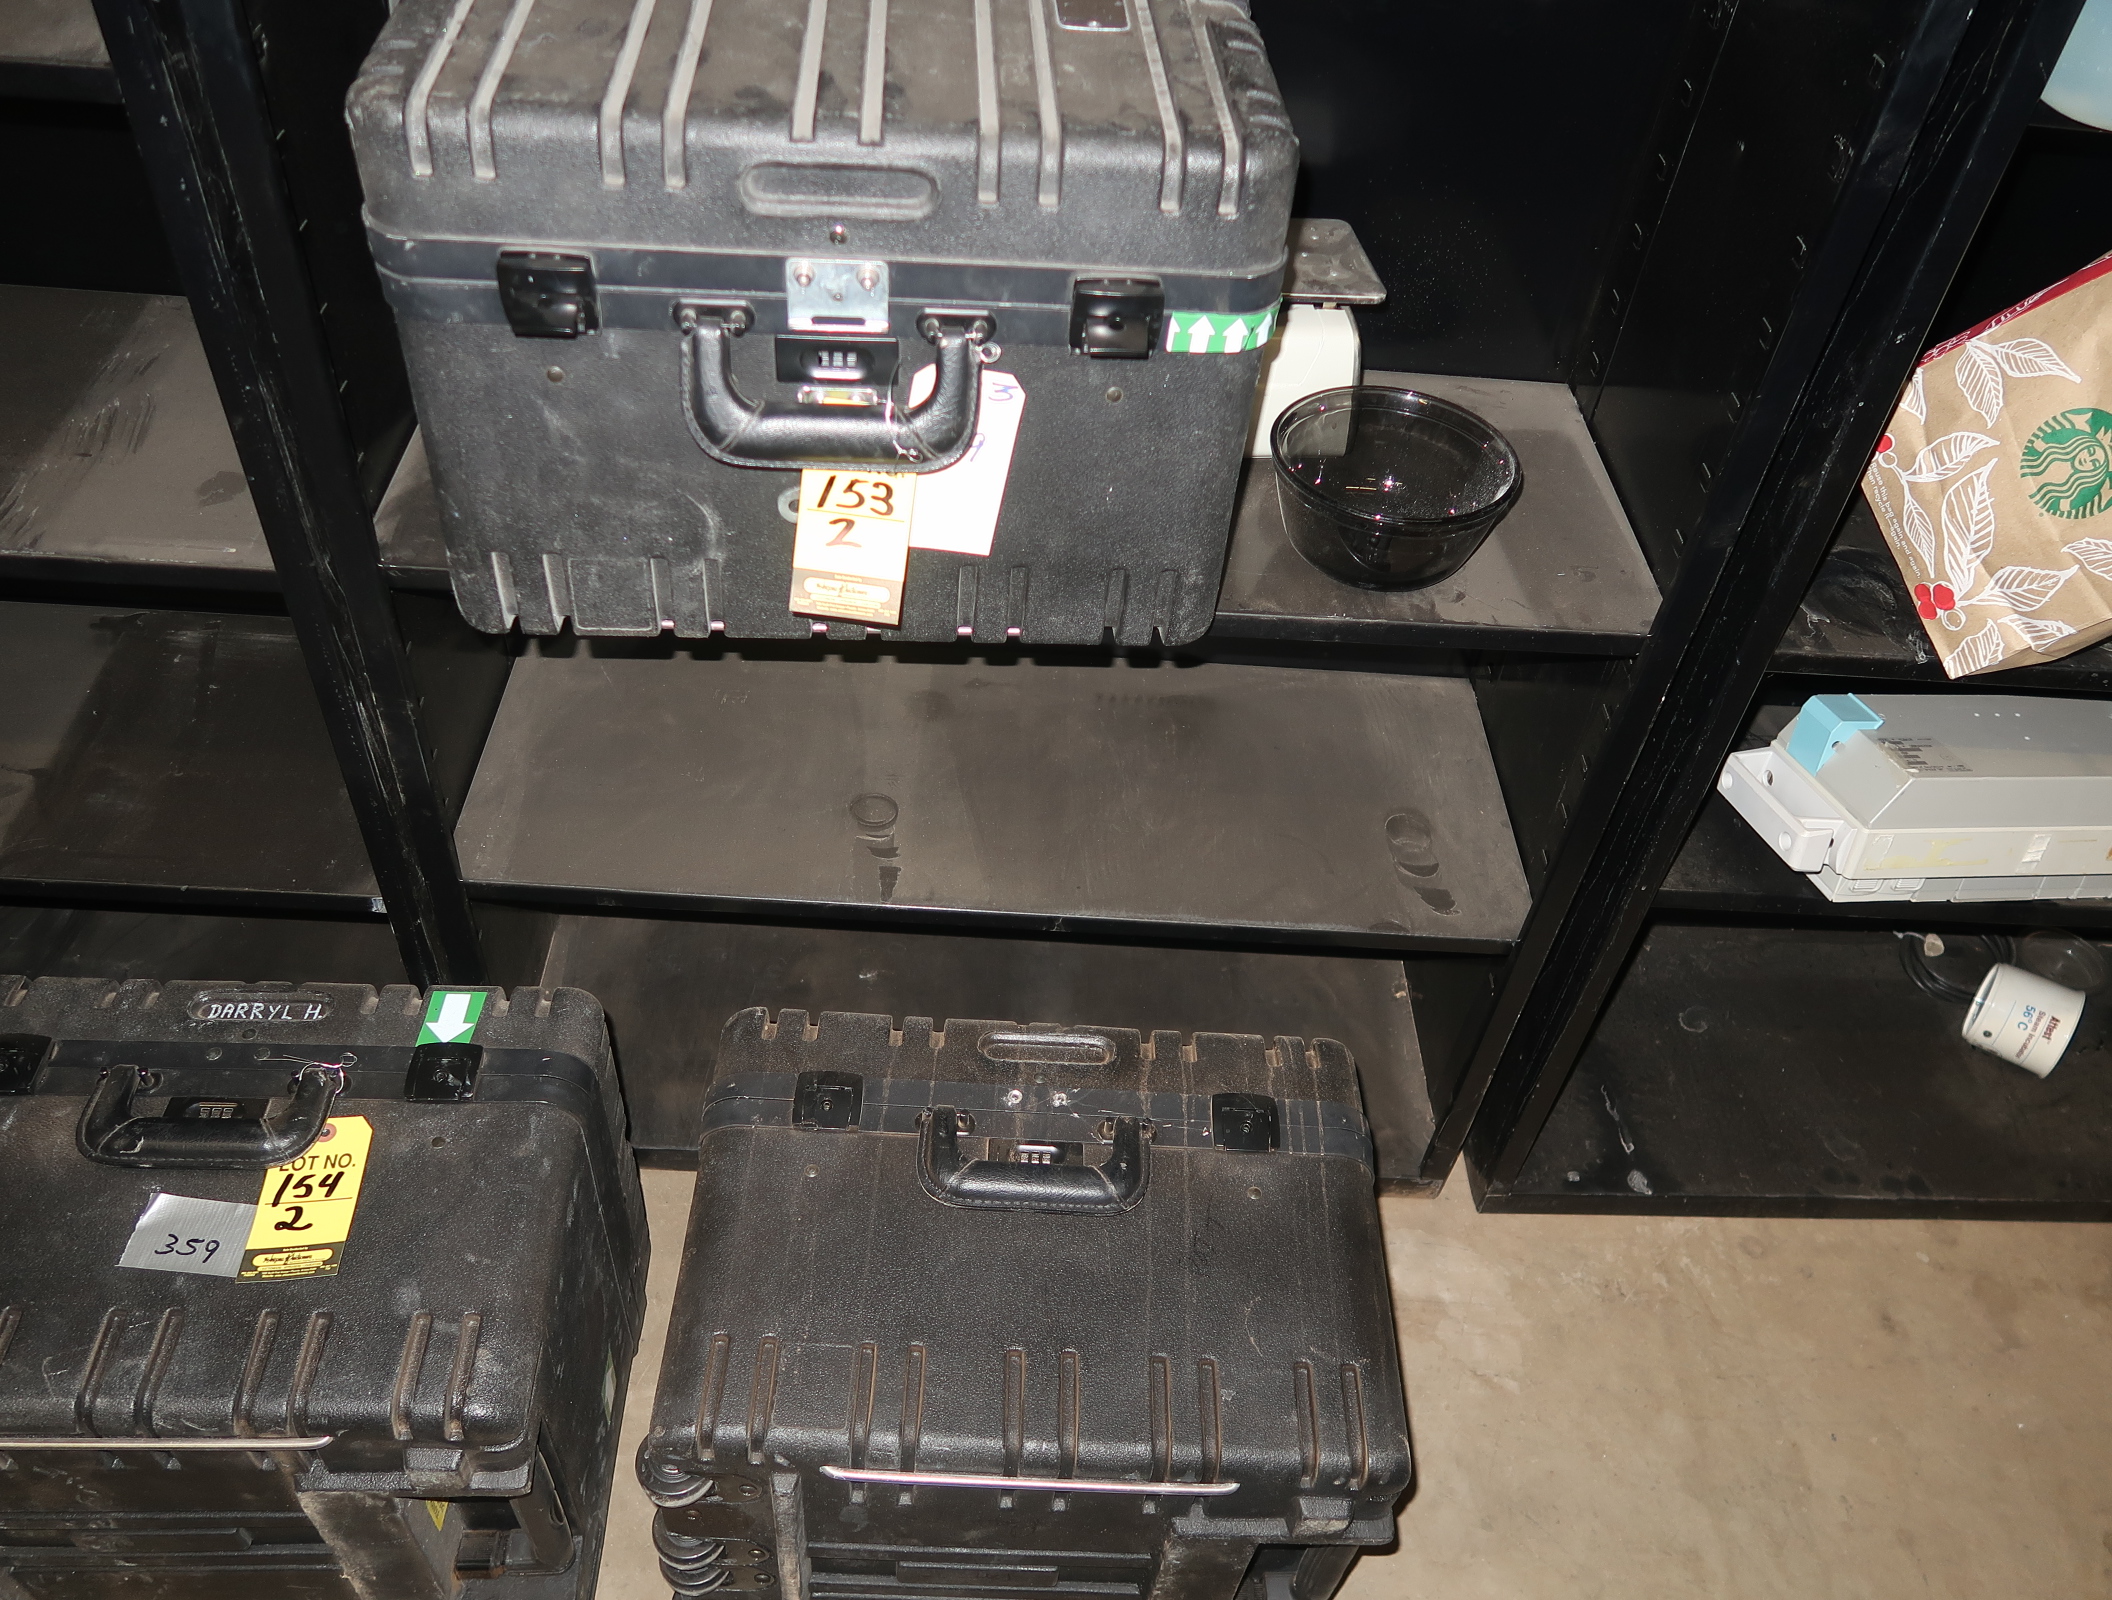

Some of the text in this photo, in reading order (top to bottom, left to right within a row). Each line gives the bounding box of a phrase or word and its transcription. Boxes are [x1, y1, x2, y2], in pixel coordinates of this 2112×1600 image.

[817, 475, 894, 516] 153
[1873, 486, 1886, 513] recycle
[826, 518, 862, 548] 2
[1870, 462, 1921, 579] Reuse this bag again and again.
[208, 1002, 292, 1020] DARRYL
[2030, 1010, 2047, 1033] Steam
[323, 1153, 356, 1170] NO.
[271, 1171, 345, 1207] 154
[274, 1206, 313, 1231] 2
[154, 1233, 220, 1264] 359
